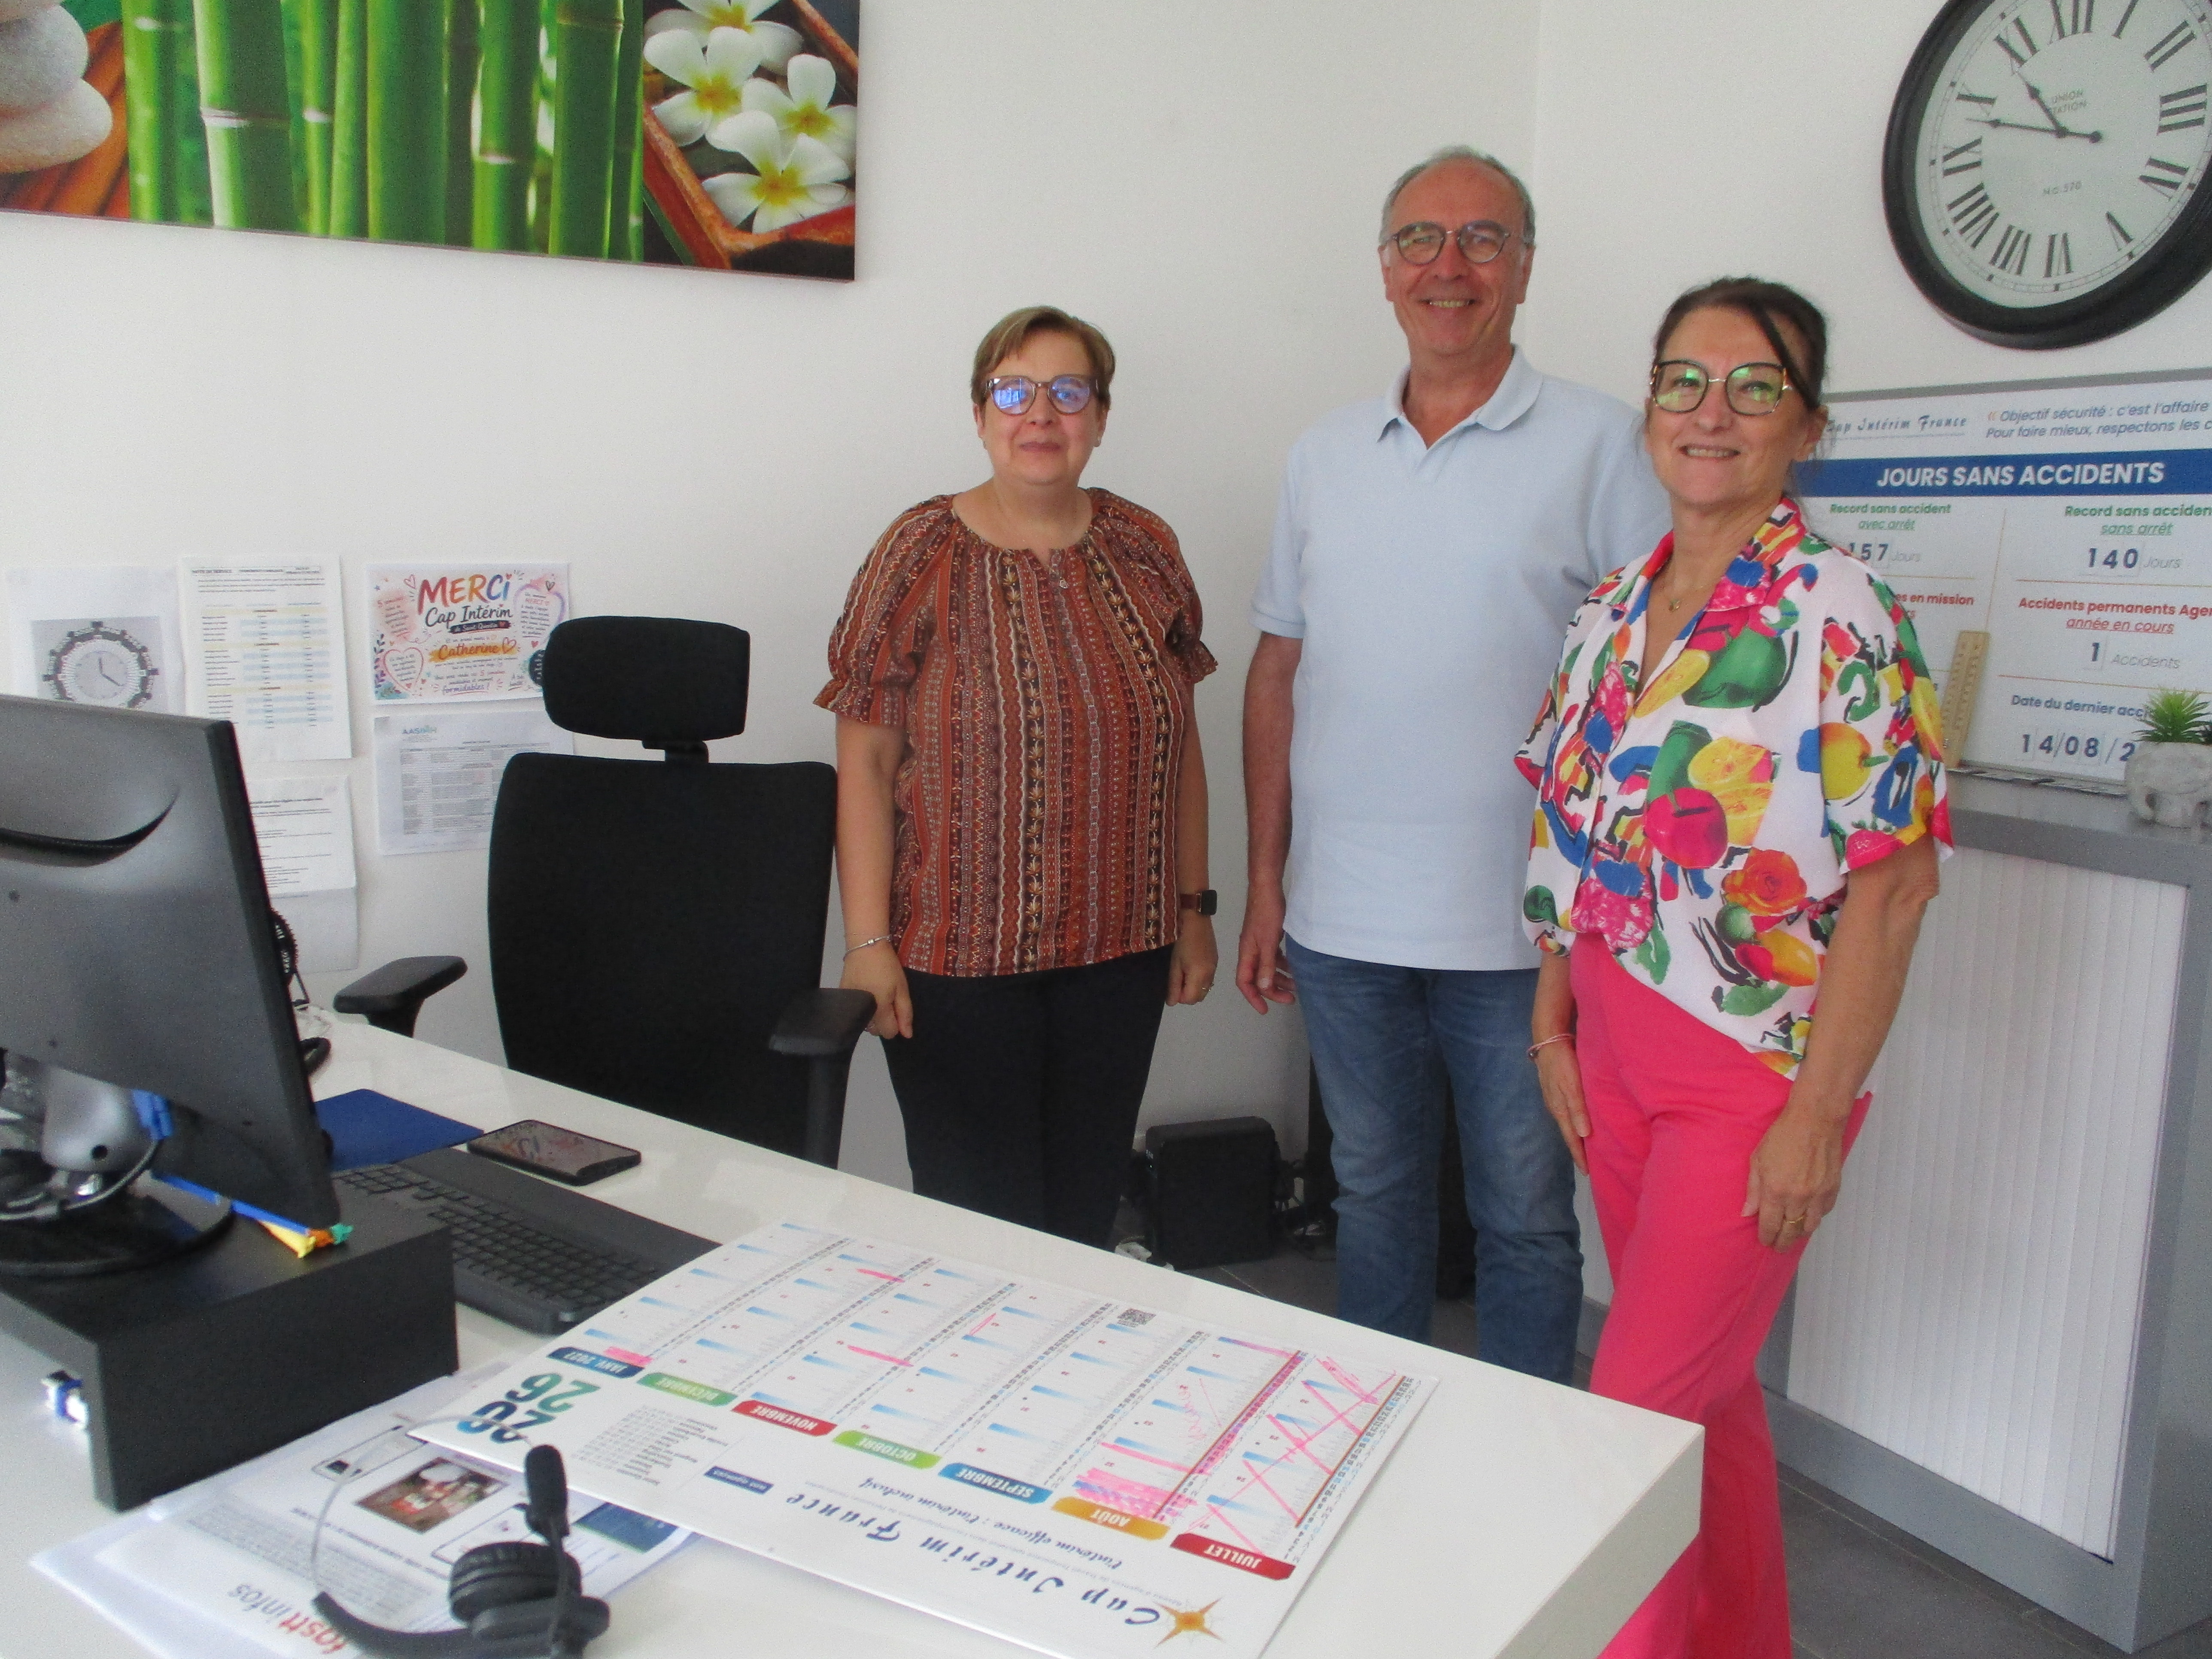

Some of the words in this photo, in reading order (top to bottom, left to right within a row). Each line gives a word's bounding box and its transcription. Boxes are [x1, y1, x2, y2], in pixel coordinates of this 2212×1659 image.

[1917, 414, 1967, 431] France
[1999, 407, 2050, 425] Objectif
[2052, 405, 2106, 422] sécurité
[1986, 425, 2014, 439] Pour
[2017, 425, 2047, 438] faire
[2049, 423, 2094, 438] mieux,
[2096, 421, 2175, 438] respectons
[2179, 418, 2200, 431] les
[1877, 467, 1948, 487] JOURS
[1952, 465, 2015, 486] SANS
[2018, 461, 2166, 486] ACCIDENTS
[1829, 503, 1869, 514] Record
[1870, 504, 1897, 514] sans
[1899, 503, 1952, 514] accident
[2065, 505, 2113, 517] Record
[2115, 506, 2149, 517] sans
[1858, 520, 1886, 530] avec
[2100, 523, 2134, 535] sans
[2137, 522, 2174, 535] arrêt
[1909, 594, 1924, 602] en
[1927, 593, 1974, 605] mission
[2019, 597, 2084, 611] Accidents
[2087, 600, 2176, 615] permanents
[425, 607, 456, 629] Cap
[460, 604, 514, 623] Intérim
[2066, 617, 2110, 630] année
[2112, 620, 2131, 631] en
[2134, 621, 2176, 634] cours
[438, 643, 499, 660] Catherine
[2110, 654, 2181, 669] Accidents
[2011, 694, 2042, 708] Date
[2044, 697, 2062, 710] du
[2064, 699, 2116, 714] dernier
[505, 1373, 601, 1413] 26
[456, 1400, 557, 1444] 20
[750, 1404, 818, 1431] NOVEMBRE
[858, 1436, 917, 1462] OCTOBRE
[858, 1477, 915, 1501] inclusif
[955, 1468, 1035, 1499] SEPTEMBRE
[786, 1494, 901, 1542] France
[917, 1497, 980, 1524] l'intérim
[1089, 1509, 1131, 1528] AOÛT
[994, 1522, 1052, 1544] efficace
[918, 1537, 1064, 1593] Intérim
[1056, 1540, 1122, 1570] l'intérim
[1203, 1543, 1263, 1568] JUILLET
[227, 1584, 293, 1624] infos
[1081, 1588, 1161, 1625] Cap
